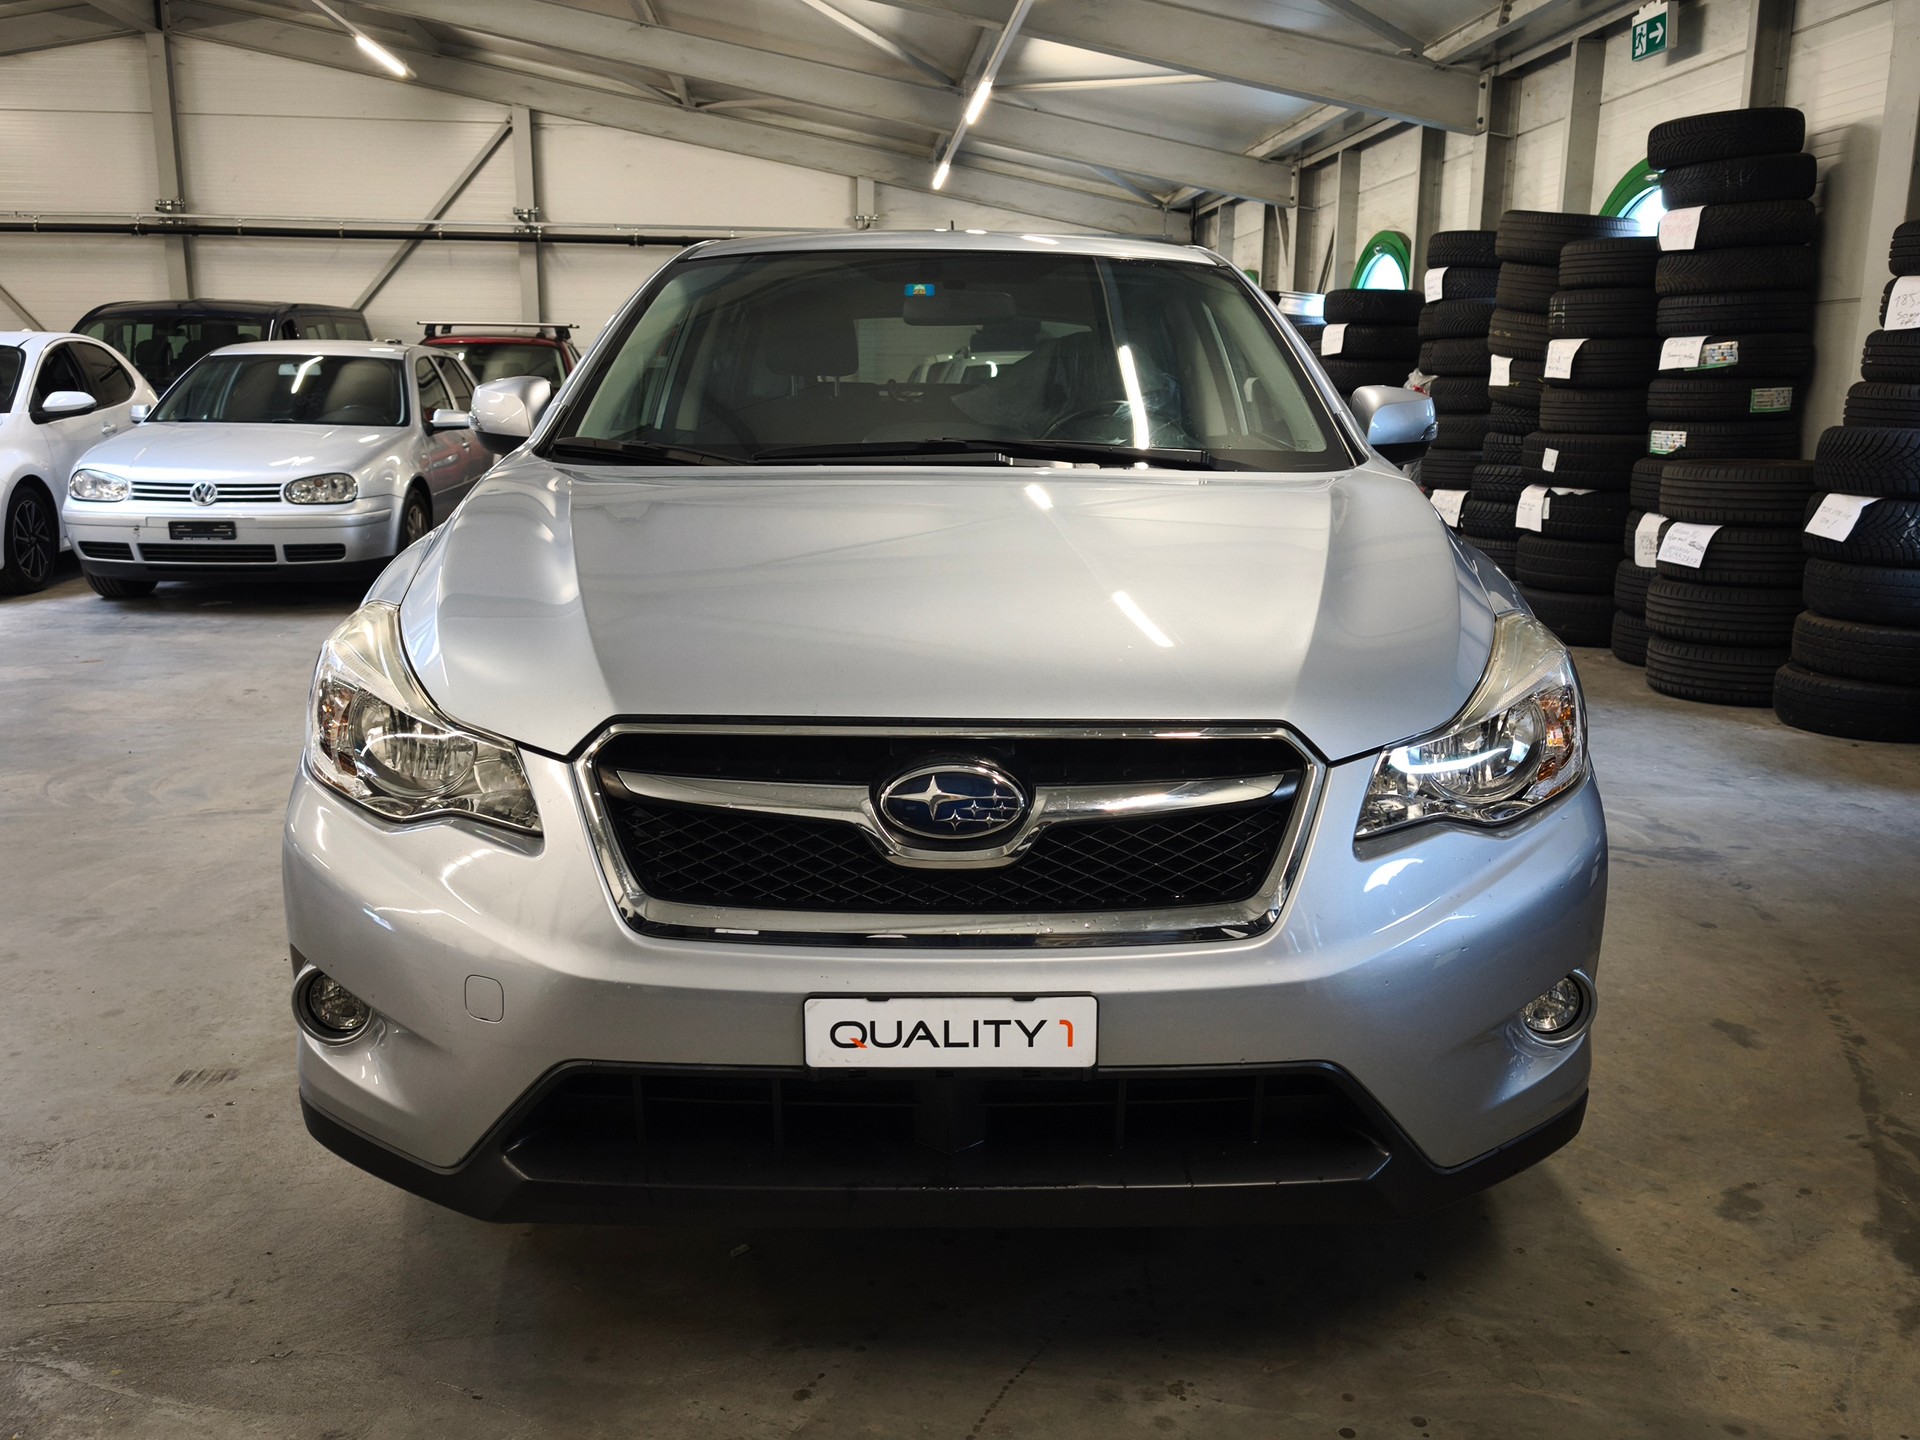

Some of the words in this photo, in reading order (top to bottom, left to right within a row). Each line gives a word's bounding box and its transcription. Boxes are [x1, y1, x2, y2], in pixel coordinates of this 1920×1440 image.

[190, 481, 217, 506] VW
[829, 1019, 1048, 1048] QUALITY
[1059, 1019, 1074, 1047] 1
